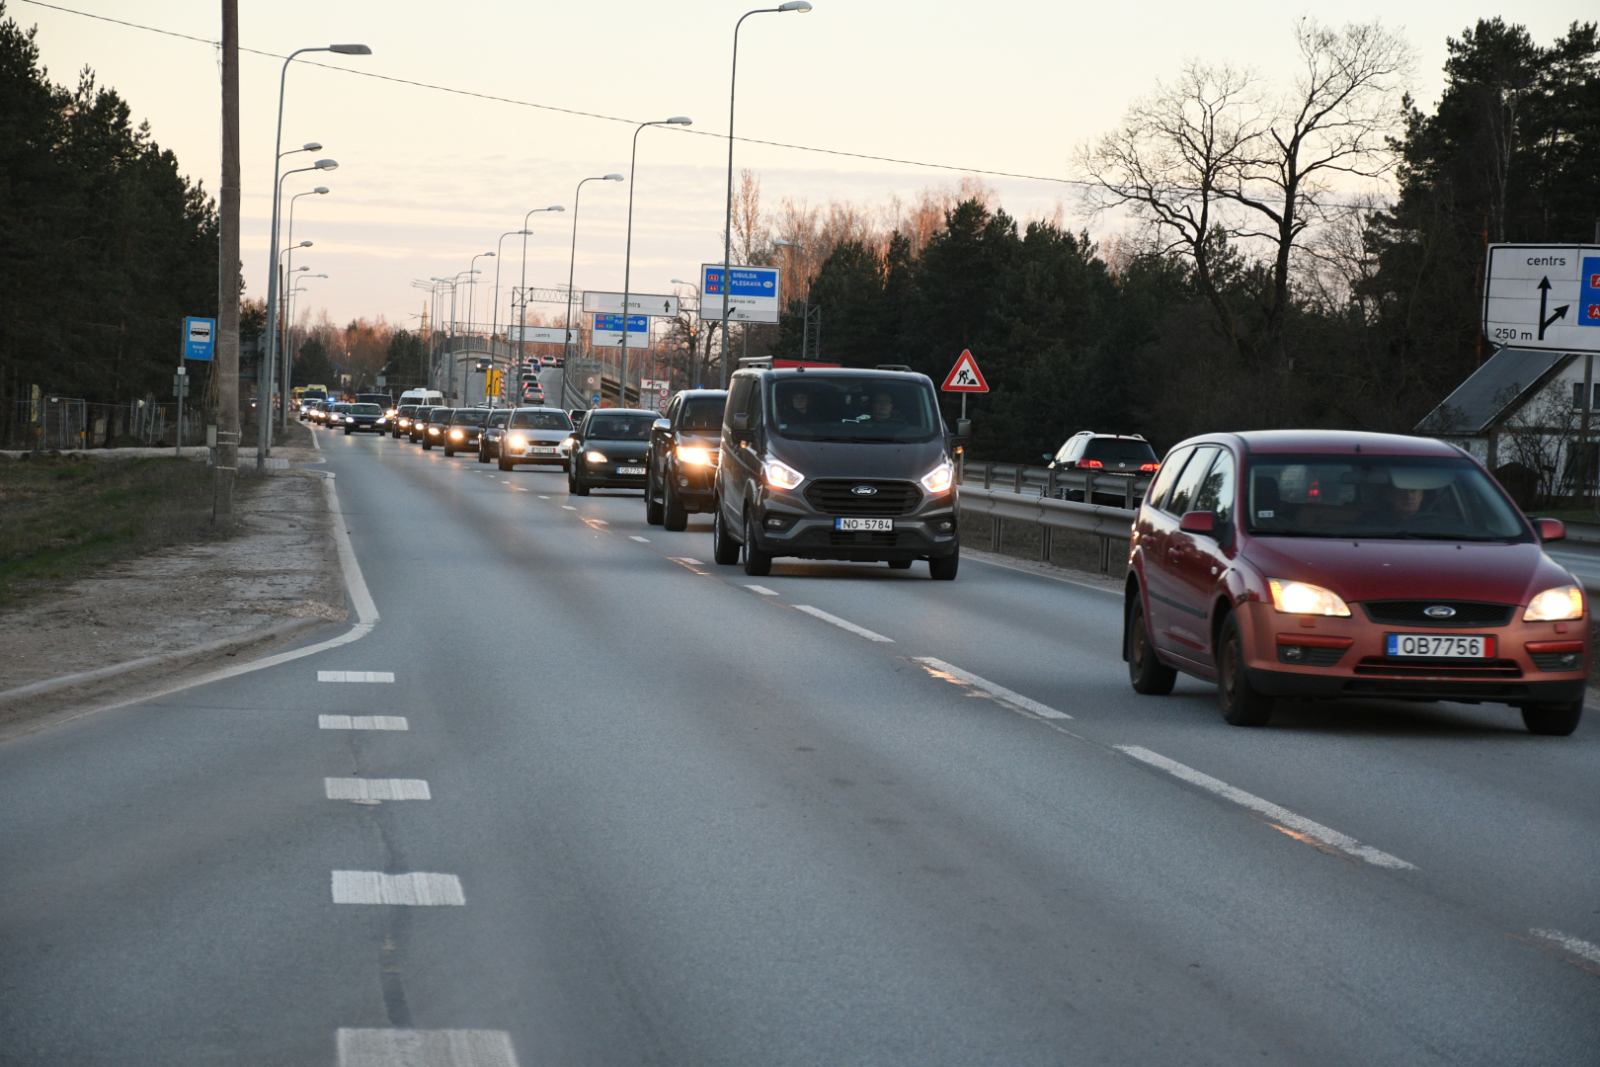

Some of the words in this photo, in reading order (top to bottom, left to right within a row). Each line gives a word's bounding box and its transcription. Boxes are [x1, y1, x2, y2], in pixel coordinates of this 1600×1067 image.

[1526, 256, 1566, 266] centrs
[1495, 328, 1516, 339] 250
[1520, 332, 1532, 340] m
[843, 520, 890, 530] NO-5784
[1402, 637, 1480, 656] QB7756
